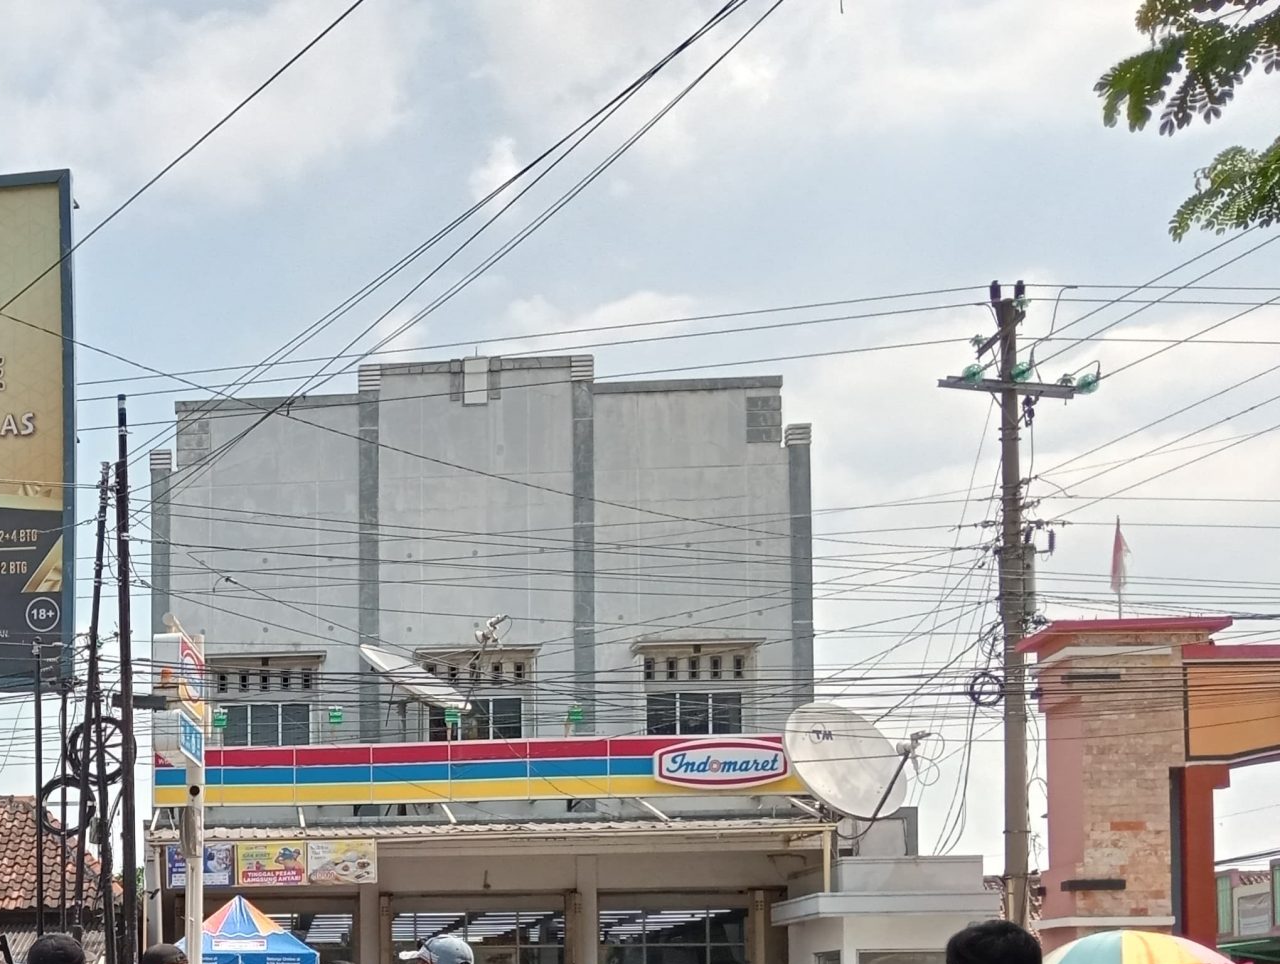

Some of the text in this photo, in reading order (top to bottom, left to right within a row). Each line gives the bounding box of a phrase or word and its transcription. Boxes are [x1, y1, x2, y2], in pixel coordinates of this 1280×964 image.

[9, 561, 28, 574] BTG
[30, 608, 55, 620] 18+
[666, 753, 779, 774] Indomaret
